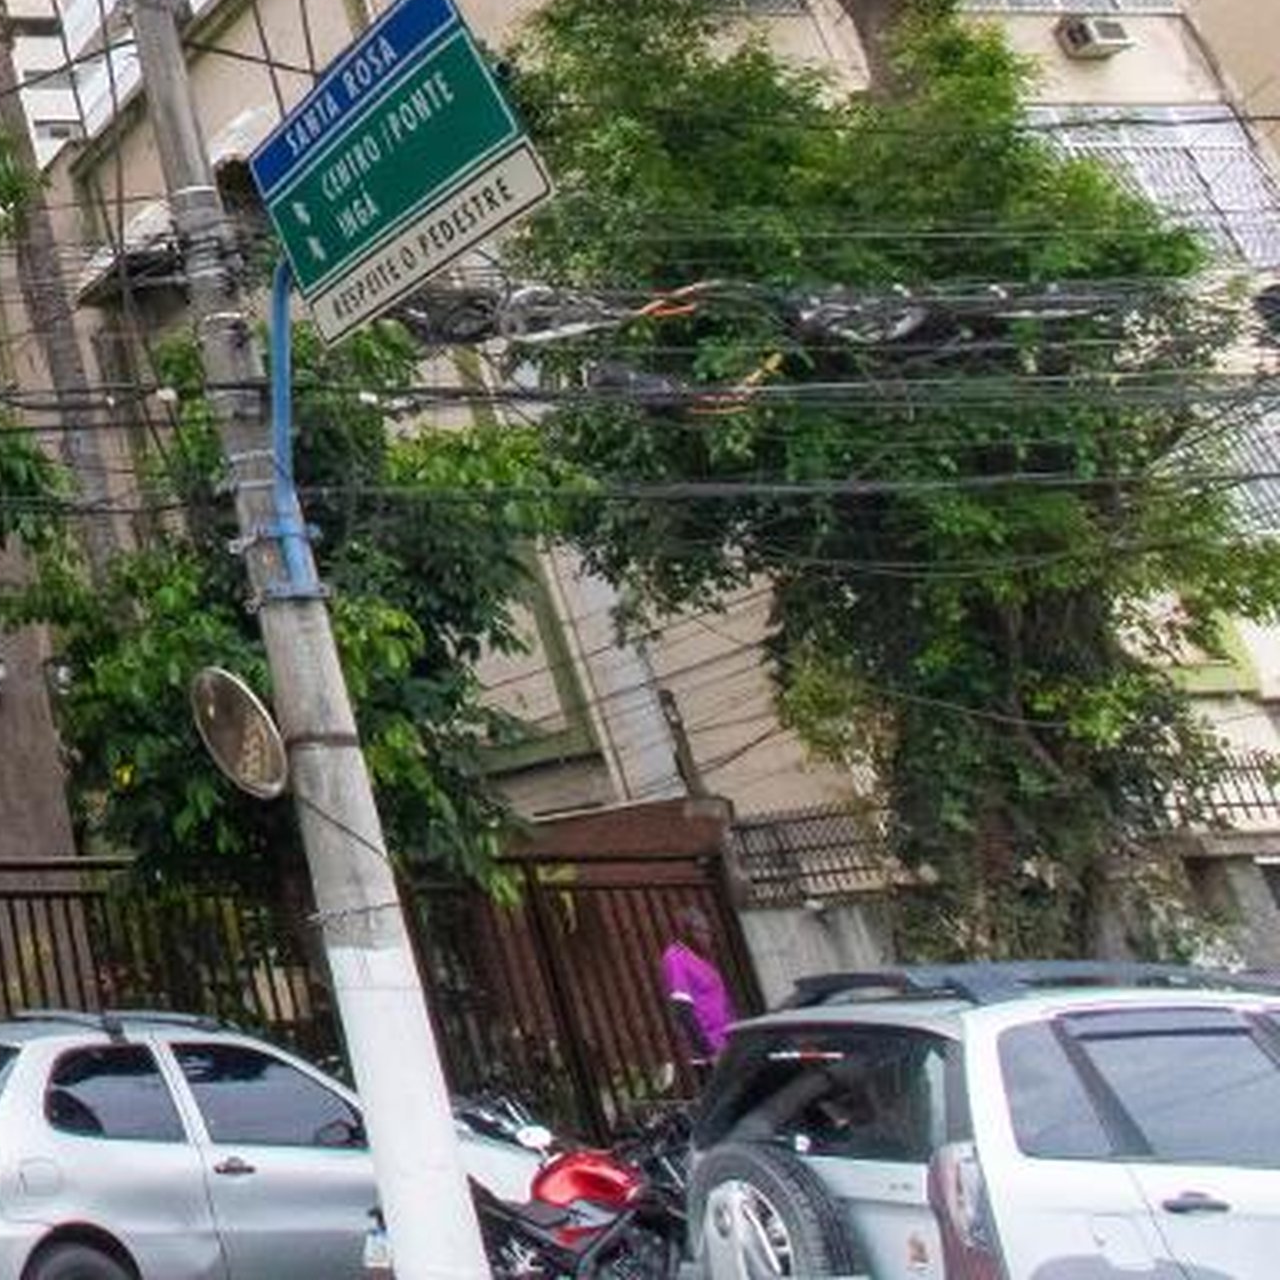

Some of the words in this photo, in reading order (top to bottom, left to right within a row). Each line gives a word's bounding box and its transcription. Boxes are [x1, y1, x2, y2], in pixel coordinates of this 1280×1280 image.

[285, 96, 340, 156] SANTA
[344, 37, 399, 98] ROSA
[321, 134, 382, 201] CENTRO
[333, 255, 402, 317] RESPEITE
[402, 247, 414, 268] O
[419, 177, 515, 257] PEDESTRE
